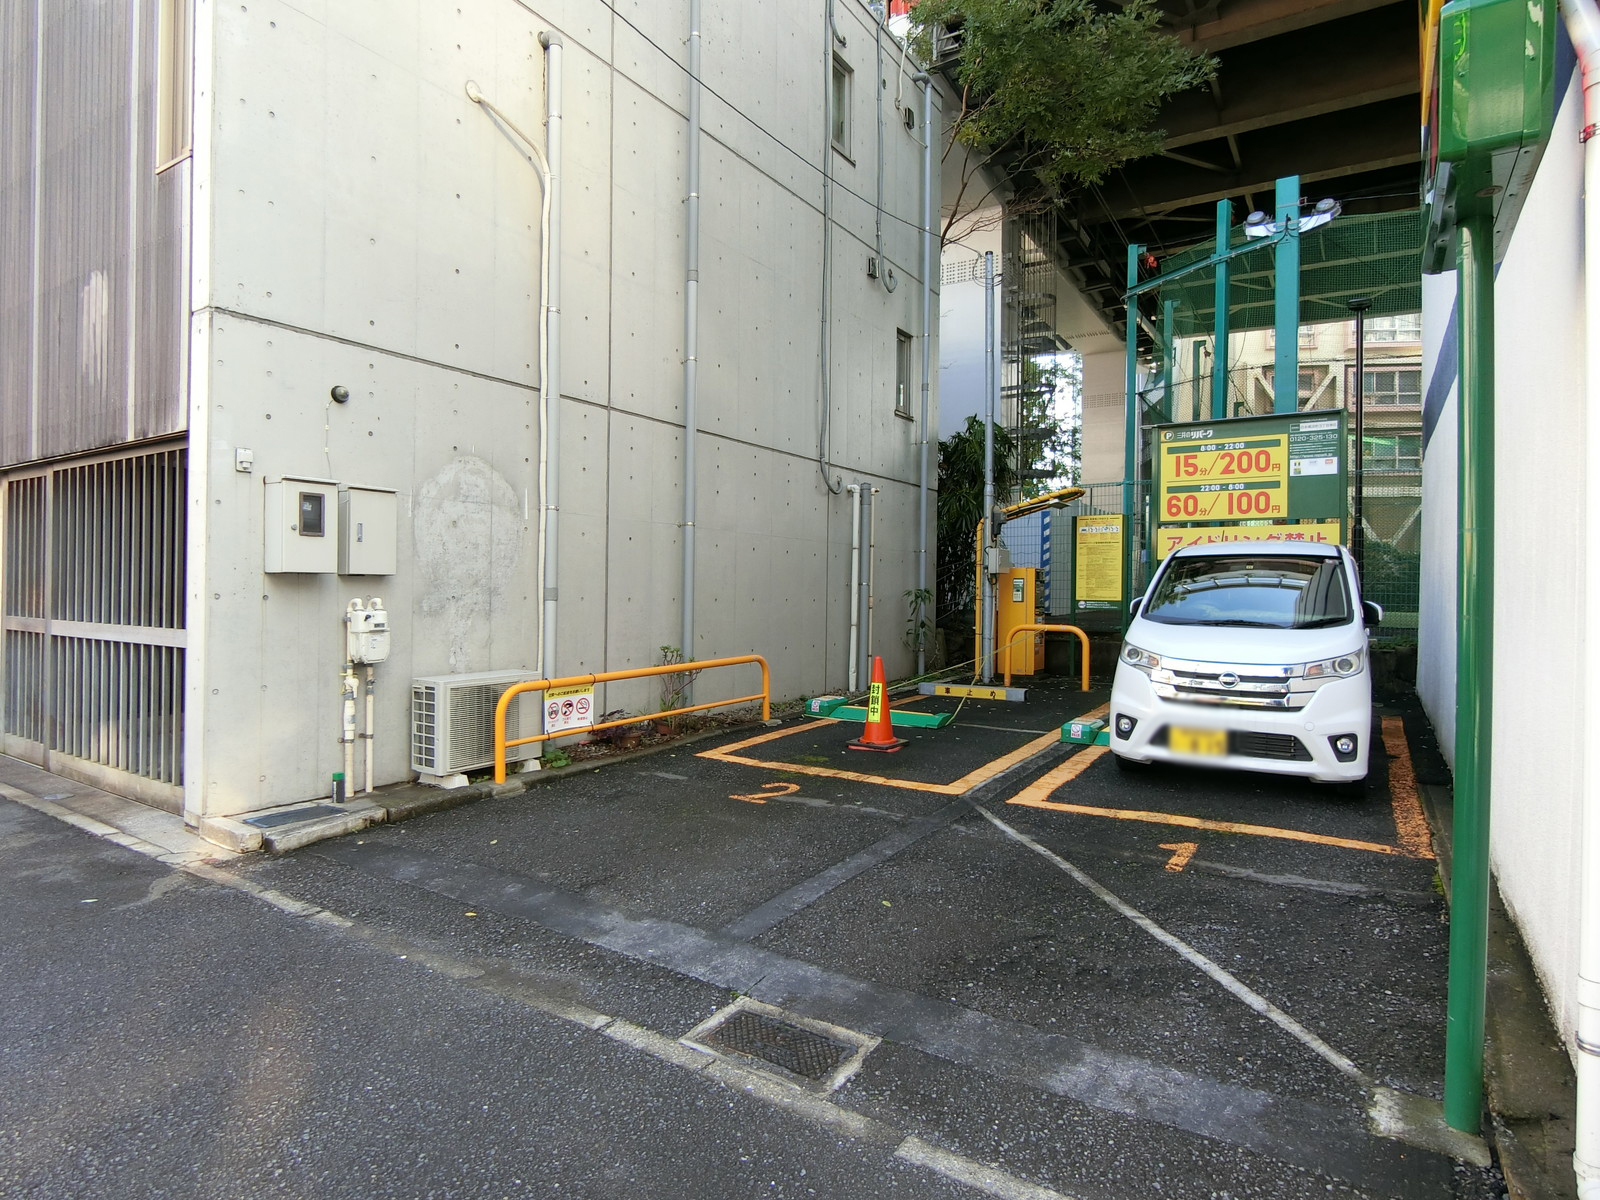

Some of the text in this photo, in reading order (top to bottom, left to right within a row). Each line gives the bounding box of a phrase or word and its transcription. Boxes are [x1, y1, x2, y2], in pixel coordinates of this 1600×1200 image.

[1177, 430, 1213, 439] 三井のリパーク
[870, 684, 881, 716] 封鎖中
[944, 687, 996, 699] 車止め
[729, 782, 800, 804] 2
[1158, 842, 1199, 873] 1
